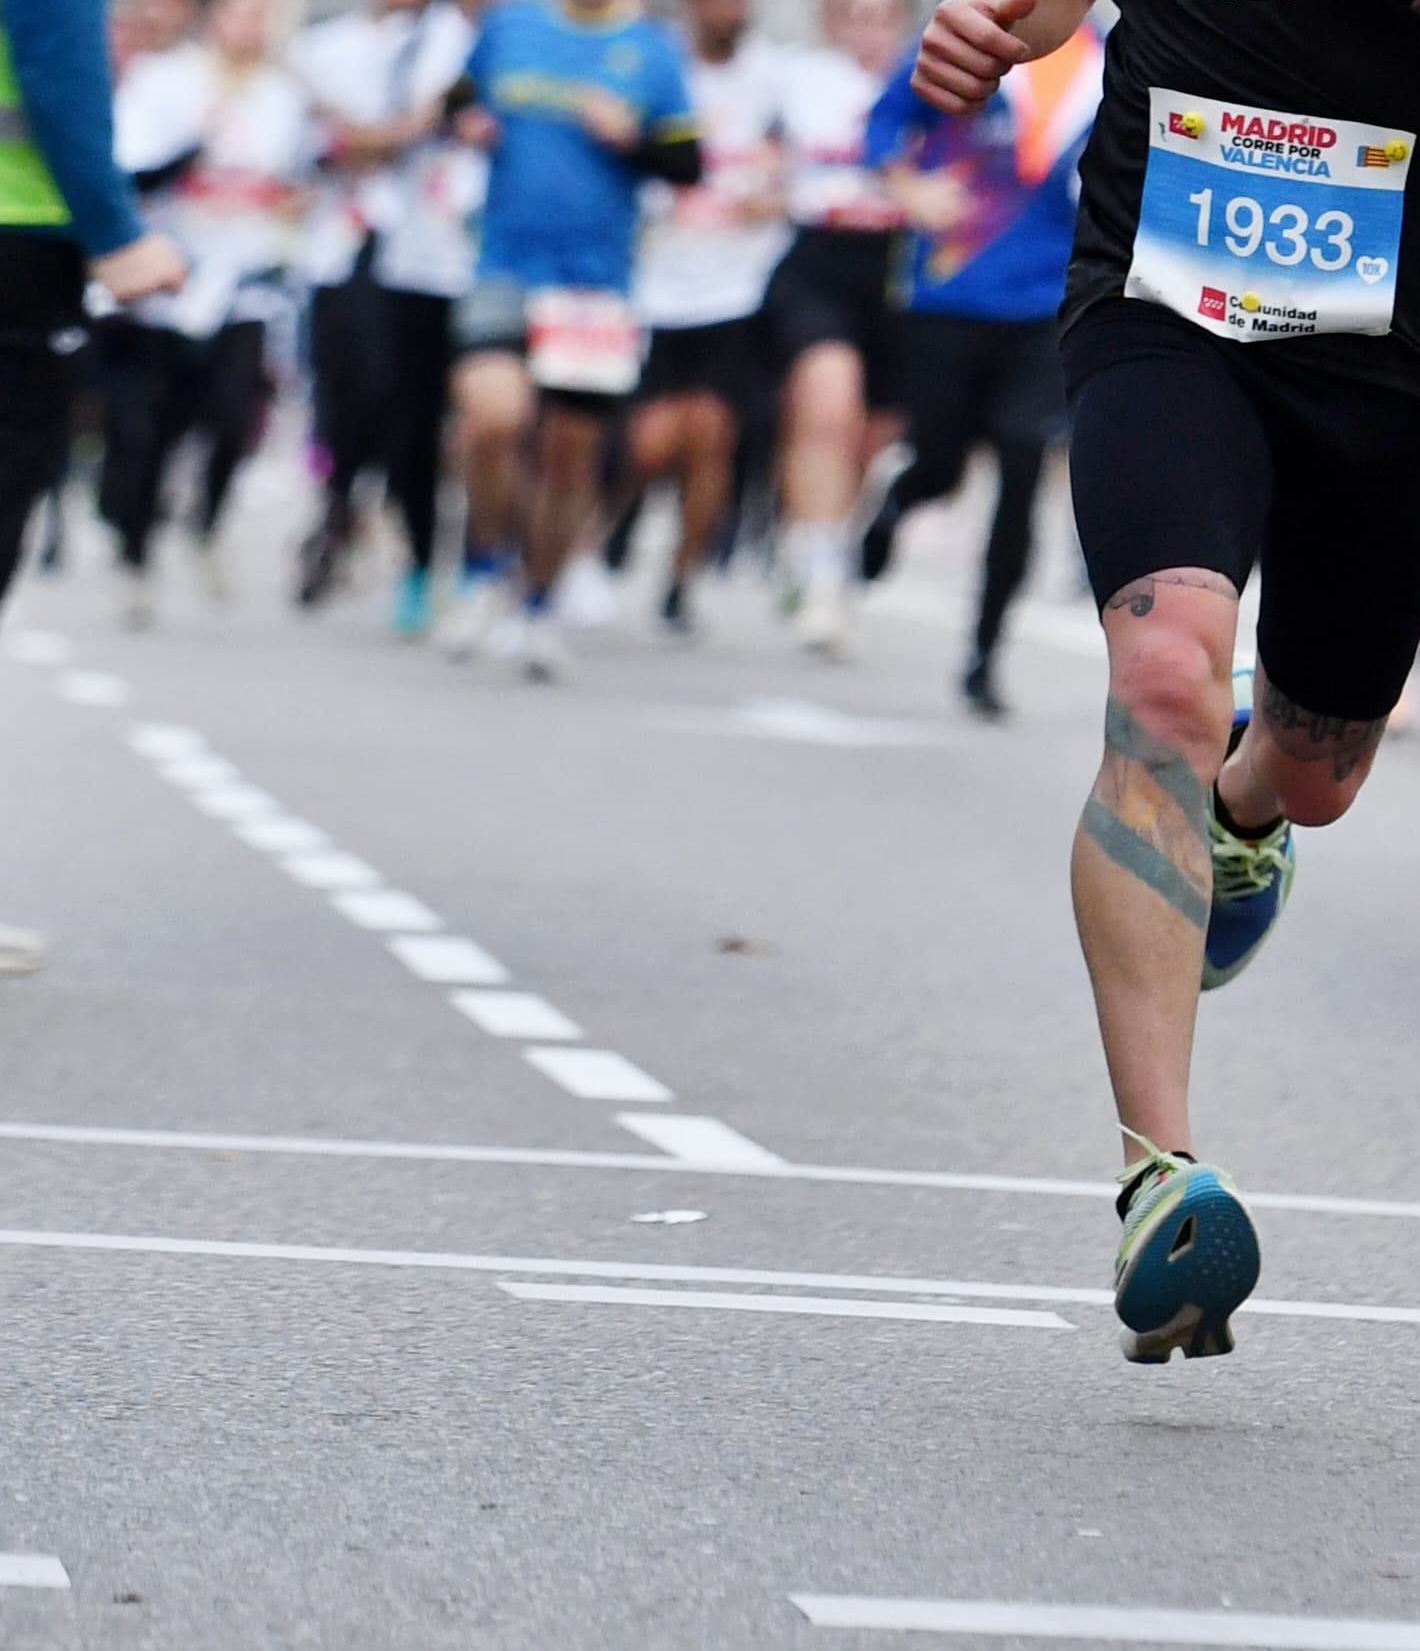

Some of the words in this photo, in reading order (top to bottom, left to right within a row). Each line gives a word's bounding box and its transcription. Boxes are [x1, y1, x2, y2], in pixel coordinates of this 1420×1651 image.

[1221, 112, 1337, 148] MADRID
[1220, 144, 1332, 178] VALENCIA
[1232, 136, 1285, 154] CORRE
[1288, 145, 1321, 159] POR
[1189, 188, 1355, 271] 1933
[1229, 313, 1245, 328] de
[1252, 318, 1316, 333] Madrid
